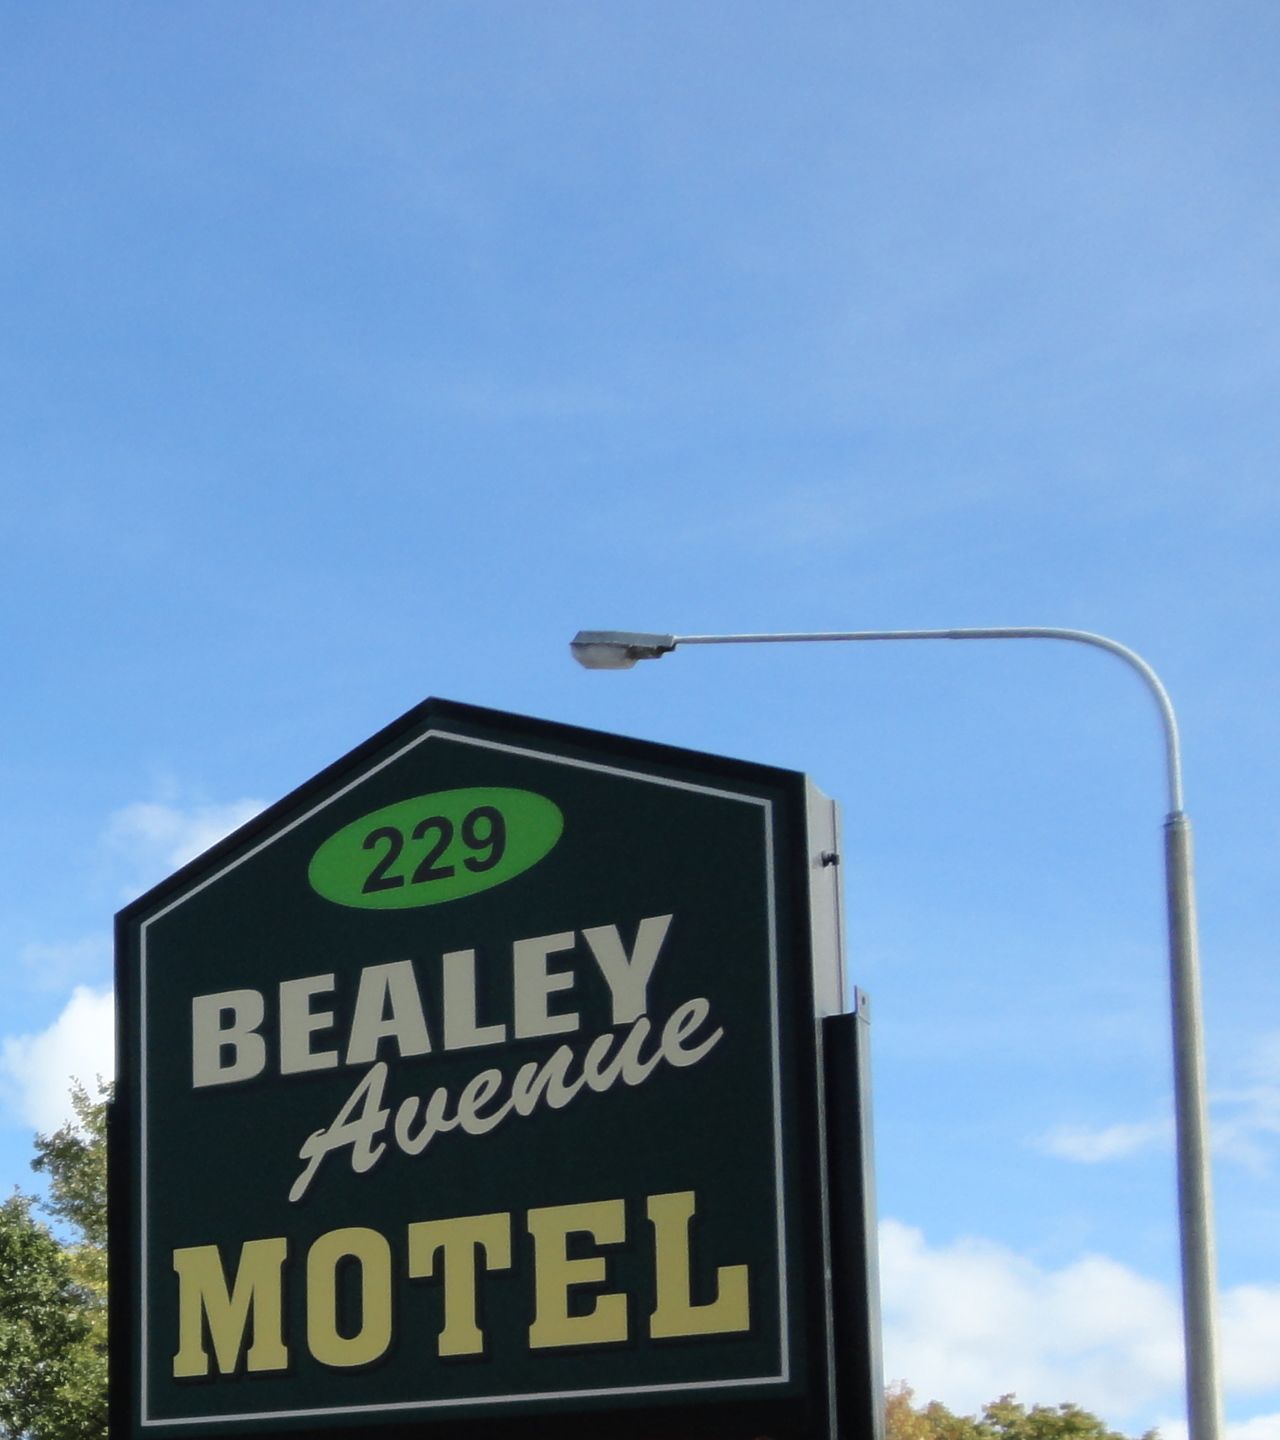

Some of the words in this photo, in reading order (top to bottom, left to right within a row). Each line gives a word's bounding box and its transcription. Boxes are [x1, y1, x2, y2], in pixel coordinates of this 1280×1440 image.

[361, 805, 508, 894] 229
[192, 913, 674, 1088] BEALEY
[288, 997, 724, 1203] Avenue
[173, 1190, 751, 1378] MOTEL
